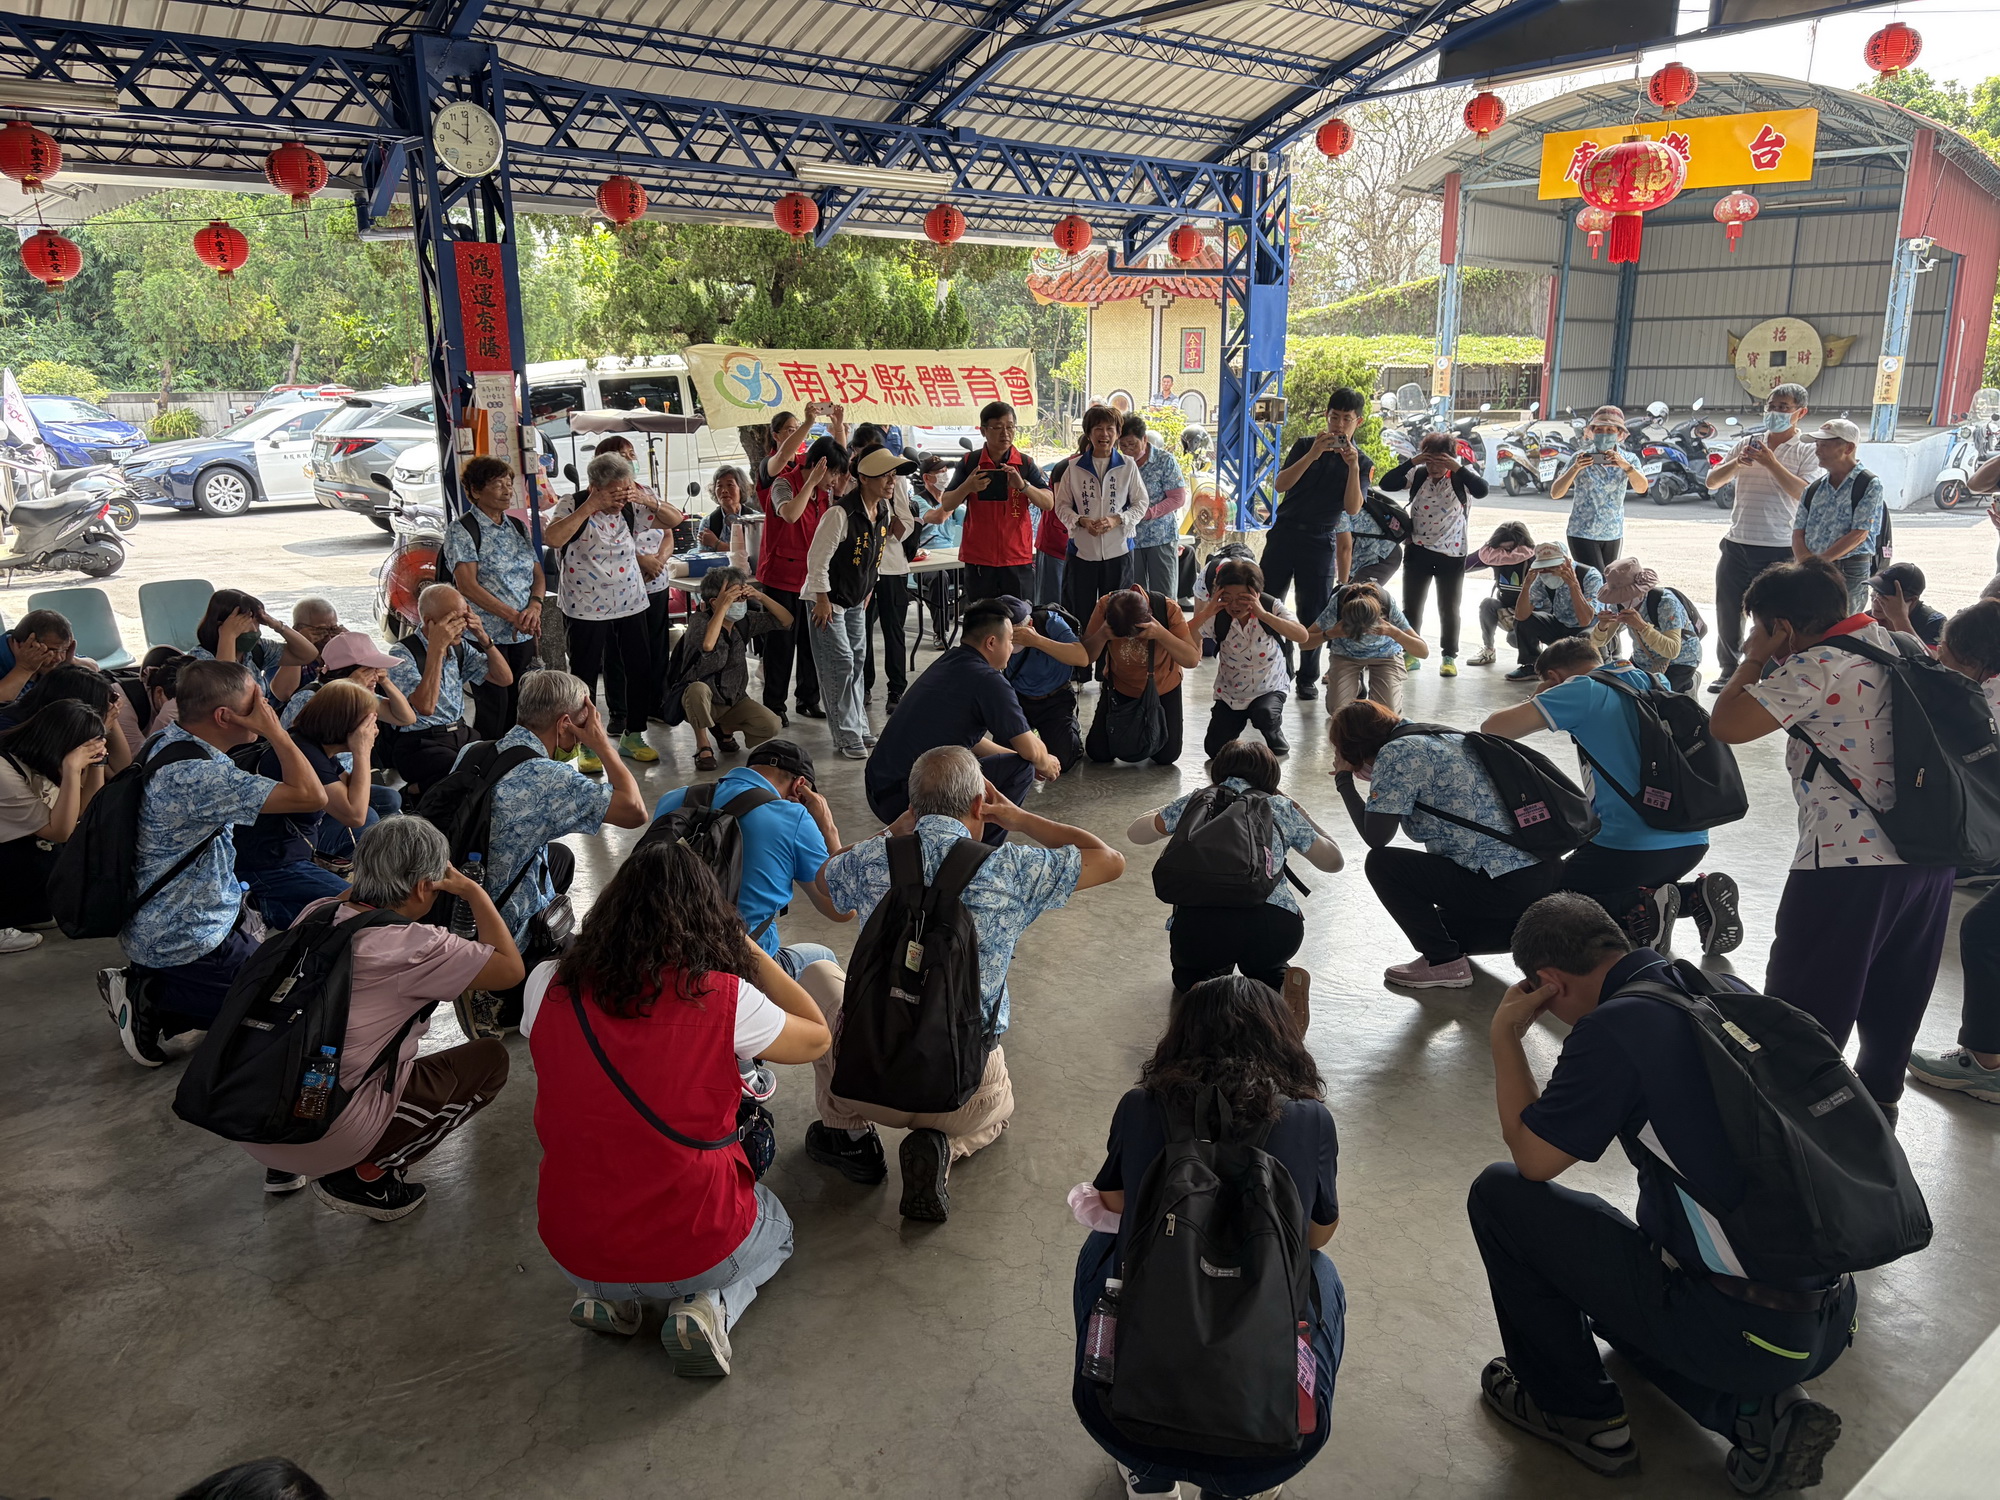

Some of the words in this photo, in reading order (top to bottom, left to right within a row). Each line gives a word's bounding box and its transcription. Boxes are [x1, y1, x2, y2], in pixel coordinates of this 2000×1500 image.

[461, 110, 469, 118] 12
[442, 122, 450, 130] 10
[484, 125, 490, 133] 2
[440, 134, 445, 142] 9
[488, 138, 494, 146] 3
[1629, 151, 1673, 192] 福
[1772, 326, 1787, 342] 招
[1186, 333, 1200, 368] 金亭
[1797, 349, 1812, 365] 財
[1747, 352, 1760, 368] 寶
[777, 360, 1035, 408] 南投縣體育會
[1109, 475, 1117, 514] 南投縣政府
[1011, 488, 1021, 518] 防災士
